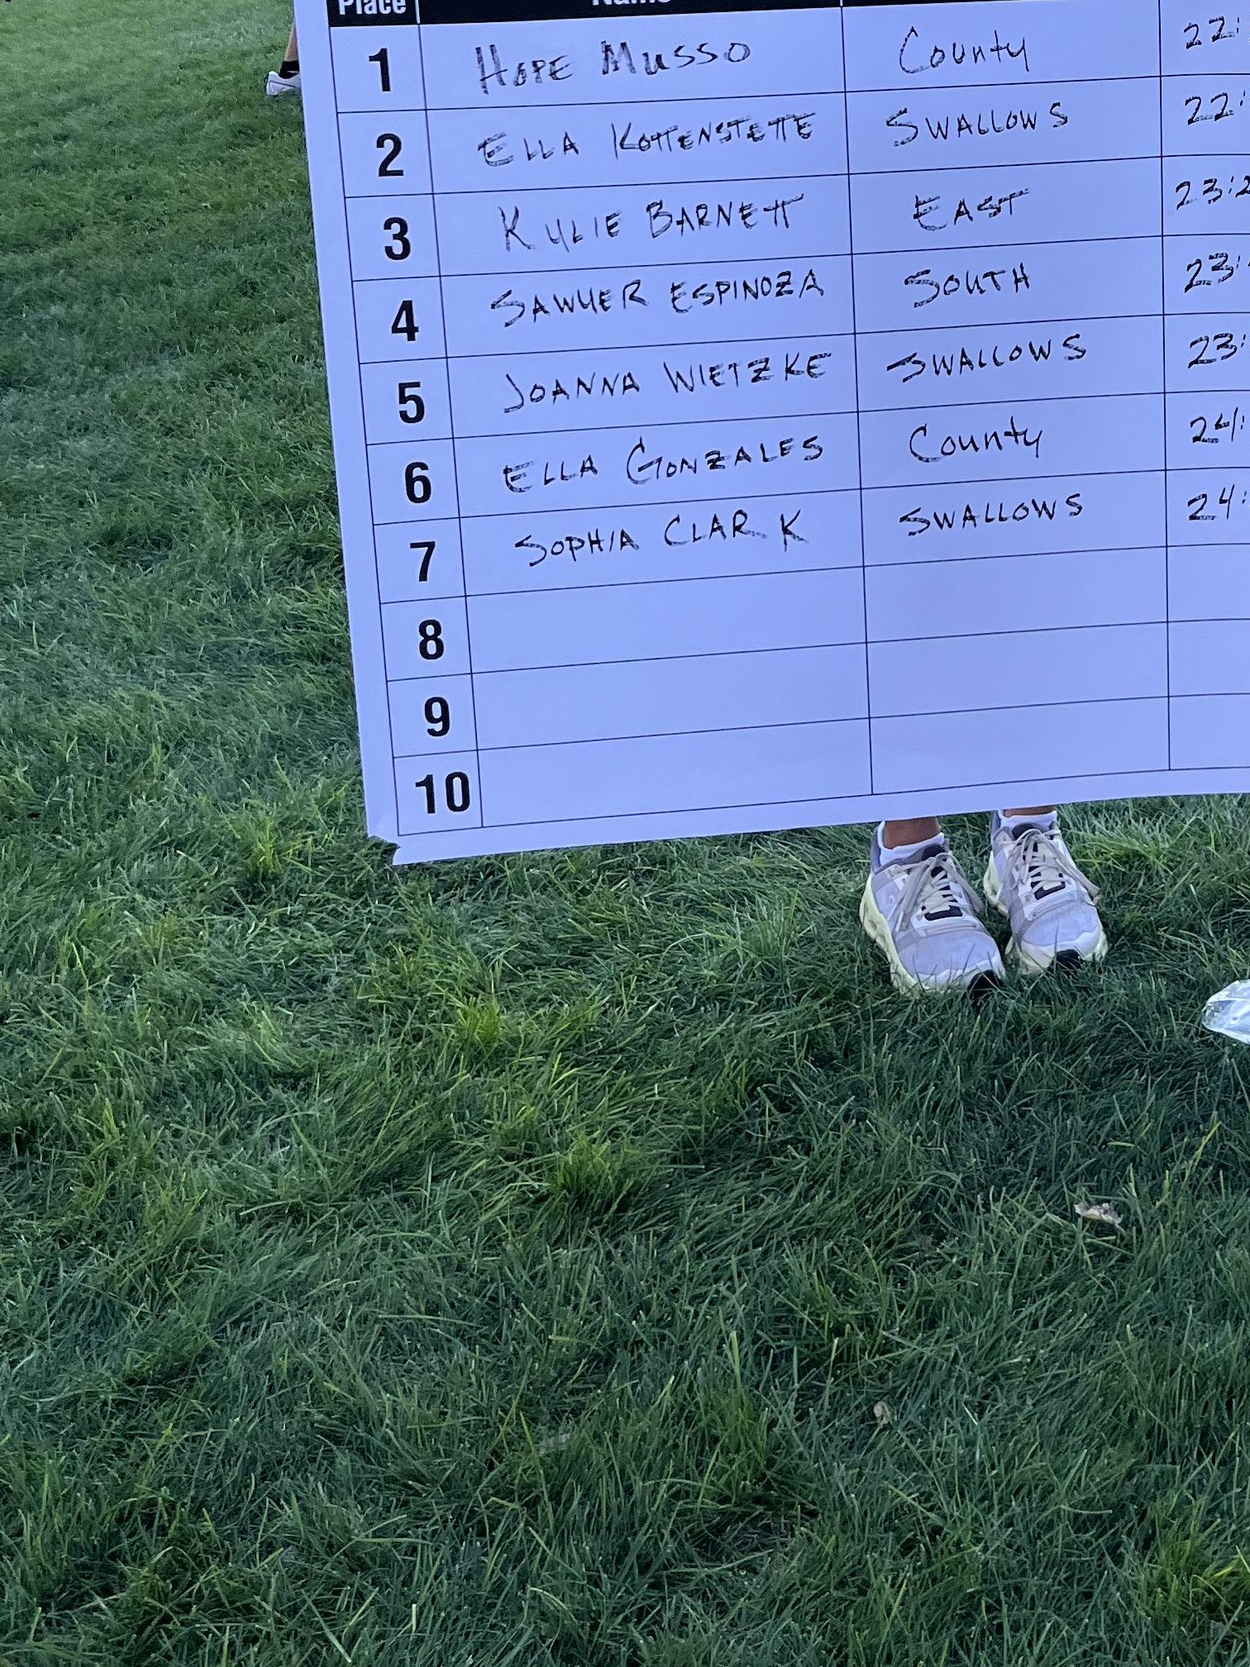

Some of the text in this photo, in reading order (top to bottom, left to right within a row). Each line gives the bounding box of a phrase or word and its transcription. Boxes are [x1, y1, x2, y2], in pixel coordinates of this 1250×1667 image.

[369, 48, 391, 92] 1
[475, 43, 575, 95] HOPE
[899, 25, 1030, 75] County
[885, 101, 1069, 147] SWALLOWS
[375, 133, 405, 178] 2
[477, 133, 580, 167] ELLA
[499, 194, 805, 253] KYLIE BARNETT
[912, 187, 1030, 232] EAST
[383, 216, 412, 261] 3
[670, 269, 825, 314] ESPINOZA
[903, 261, 1031, 309] SOUTH
[390, 299, 420, 342] 4
[886, 333, 1087, 384] SWALLOWS
[398, 381, 425, 424] 5
[504, 352, 832, 414] JOANNA WIETZKE
[908, 415, 1043, 463] County
[404, 461, 432, 504] 6
[503, 435, 824, 494] ELLA GONZALES
[899, 492, 1084, 537] SWALLOWS
[409, 542, 437, 582] 7
[514, 528, 640, 568] SOPHIA
[418, 619, 445, 661] 8
[424, 696, 451, 737] 9
[414, 771, 471, 815] 10
